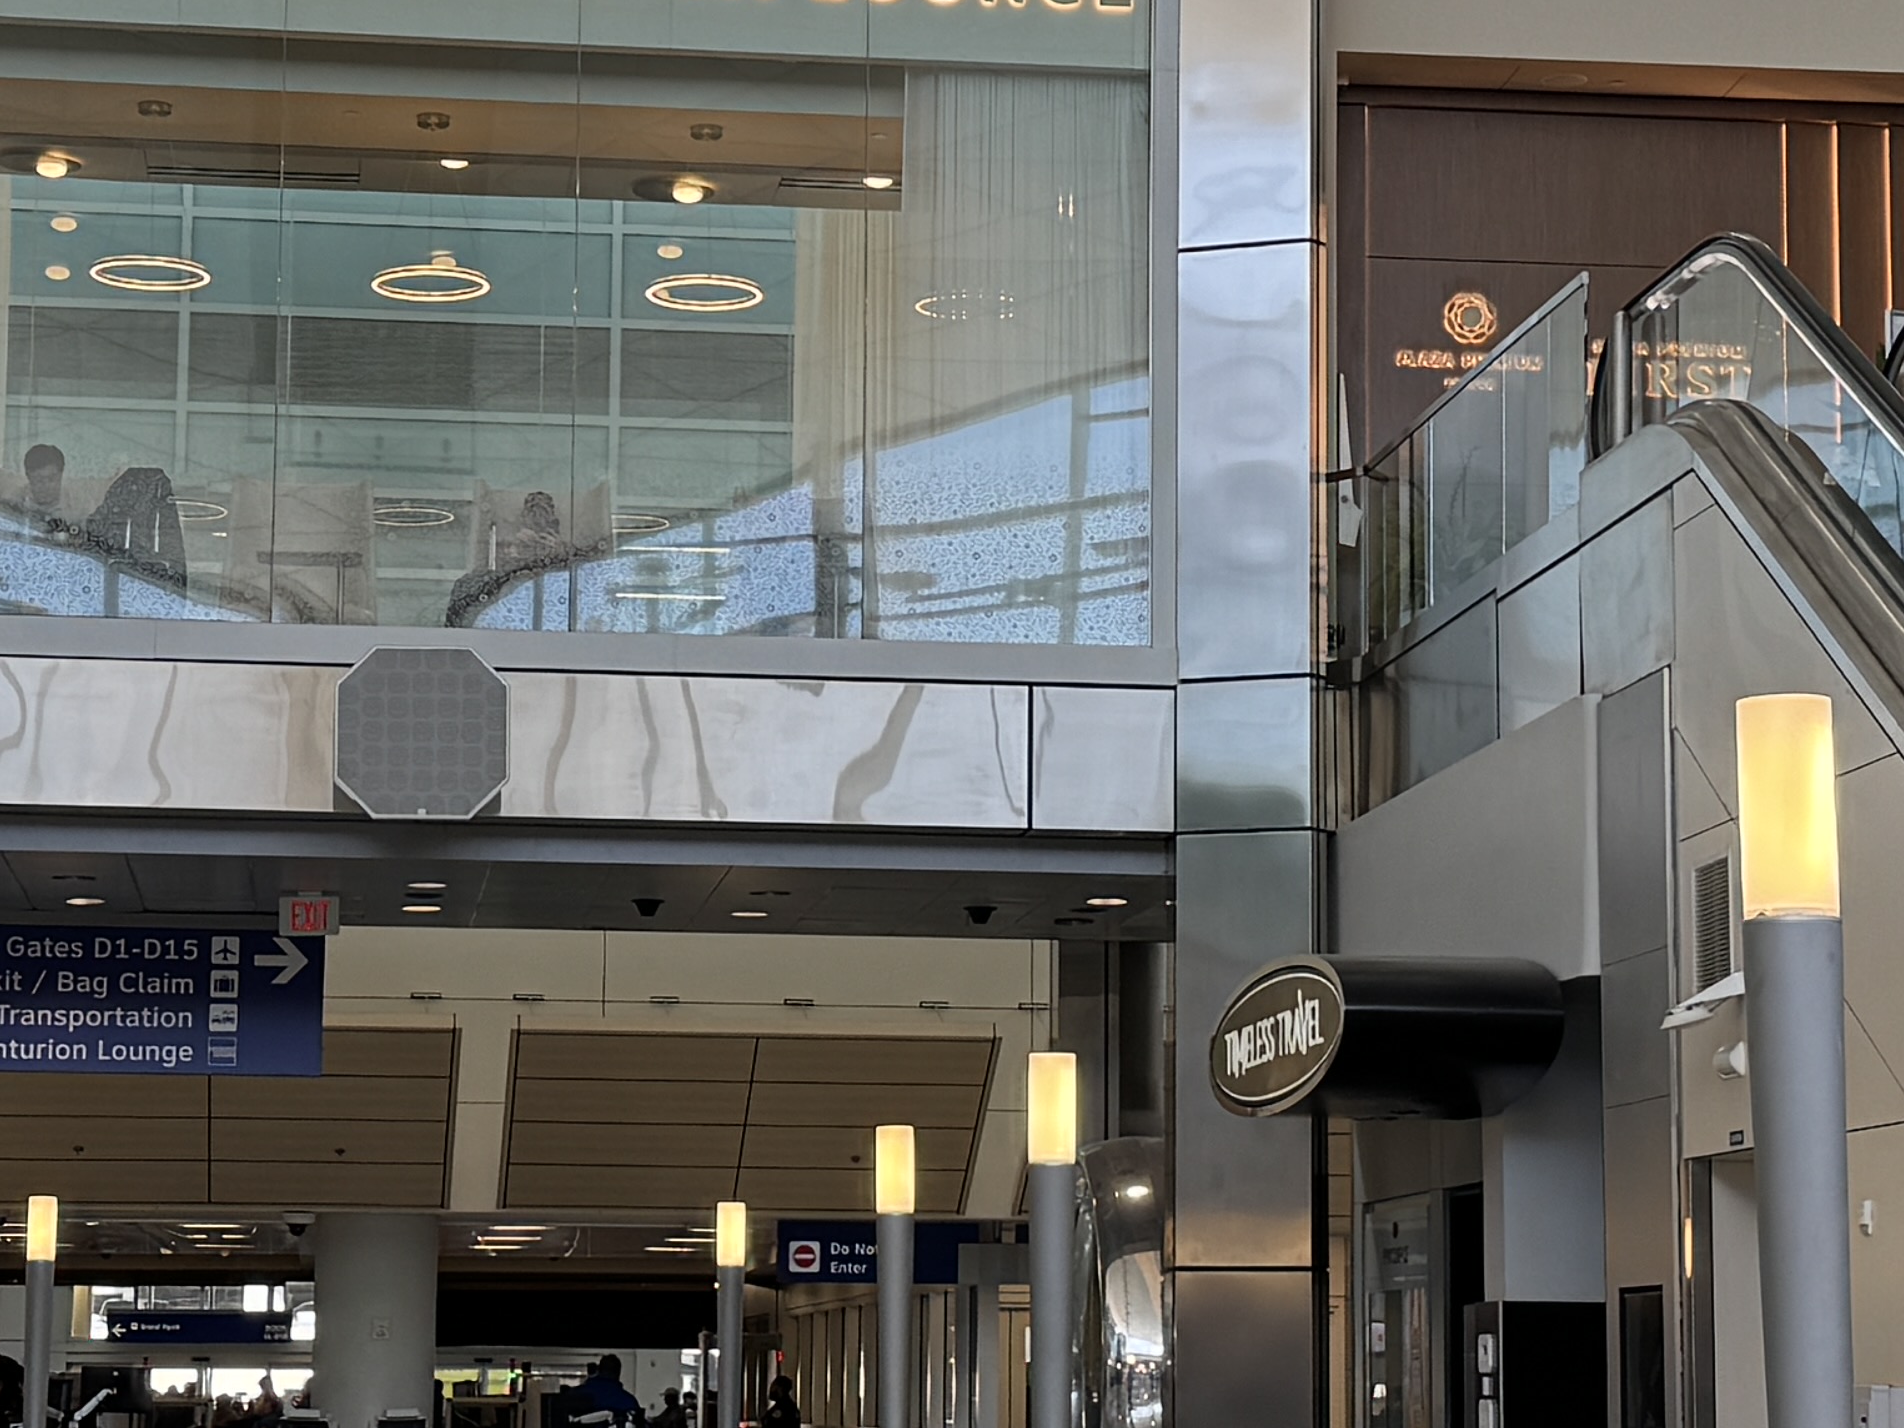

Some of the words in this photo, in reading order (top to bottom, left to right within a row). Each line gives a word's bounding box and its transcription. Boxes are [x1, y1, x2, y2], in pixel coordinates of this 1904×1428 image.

[291, 899, 331, 932] EXIT
[6, 936, 84, 959] Gates
[94, 938, 198, 960] D1-D15
[57, 972, 108, 998] Bag
[119, 972, 195, 994] Claim
[1223, 1016, 1275, 1079] TIMELESS
[1276, 988, 1325, 1056] TRAVEL
[97, 1039, 194, 1066] Lounge
[831, 1242, 850, 1255] Do
[831, 1261, 867, 1274] Enter
